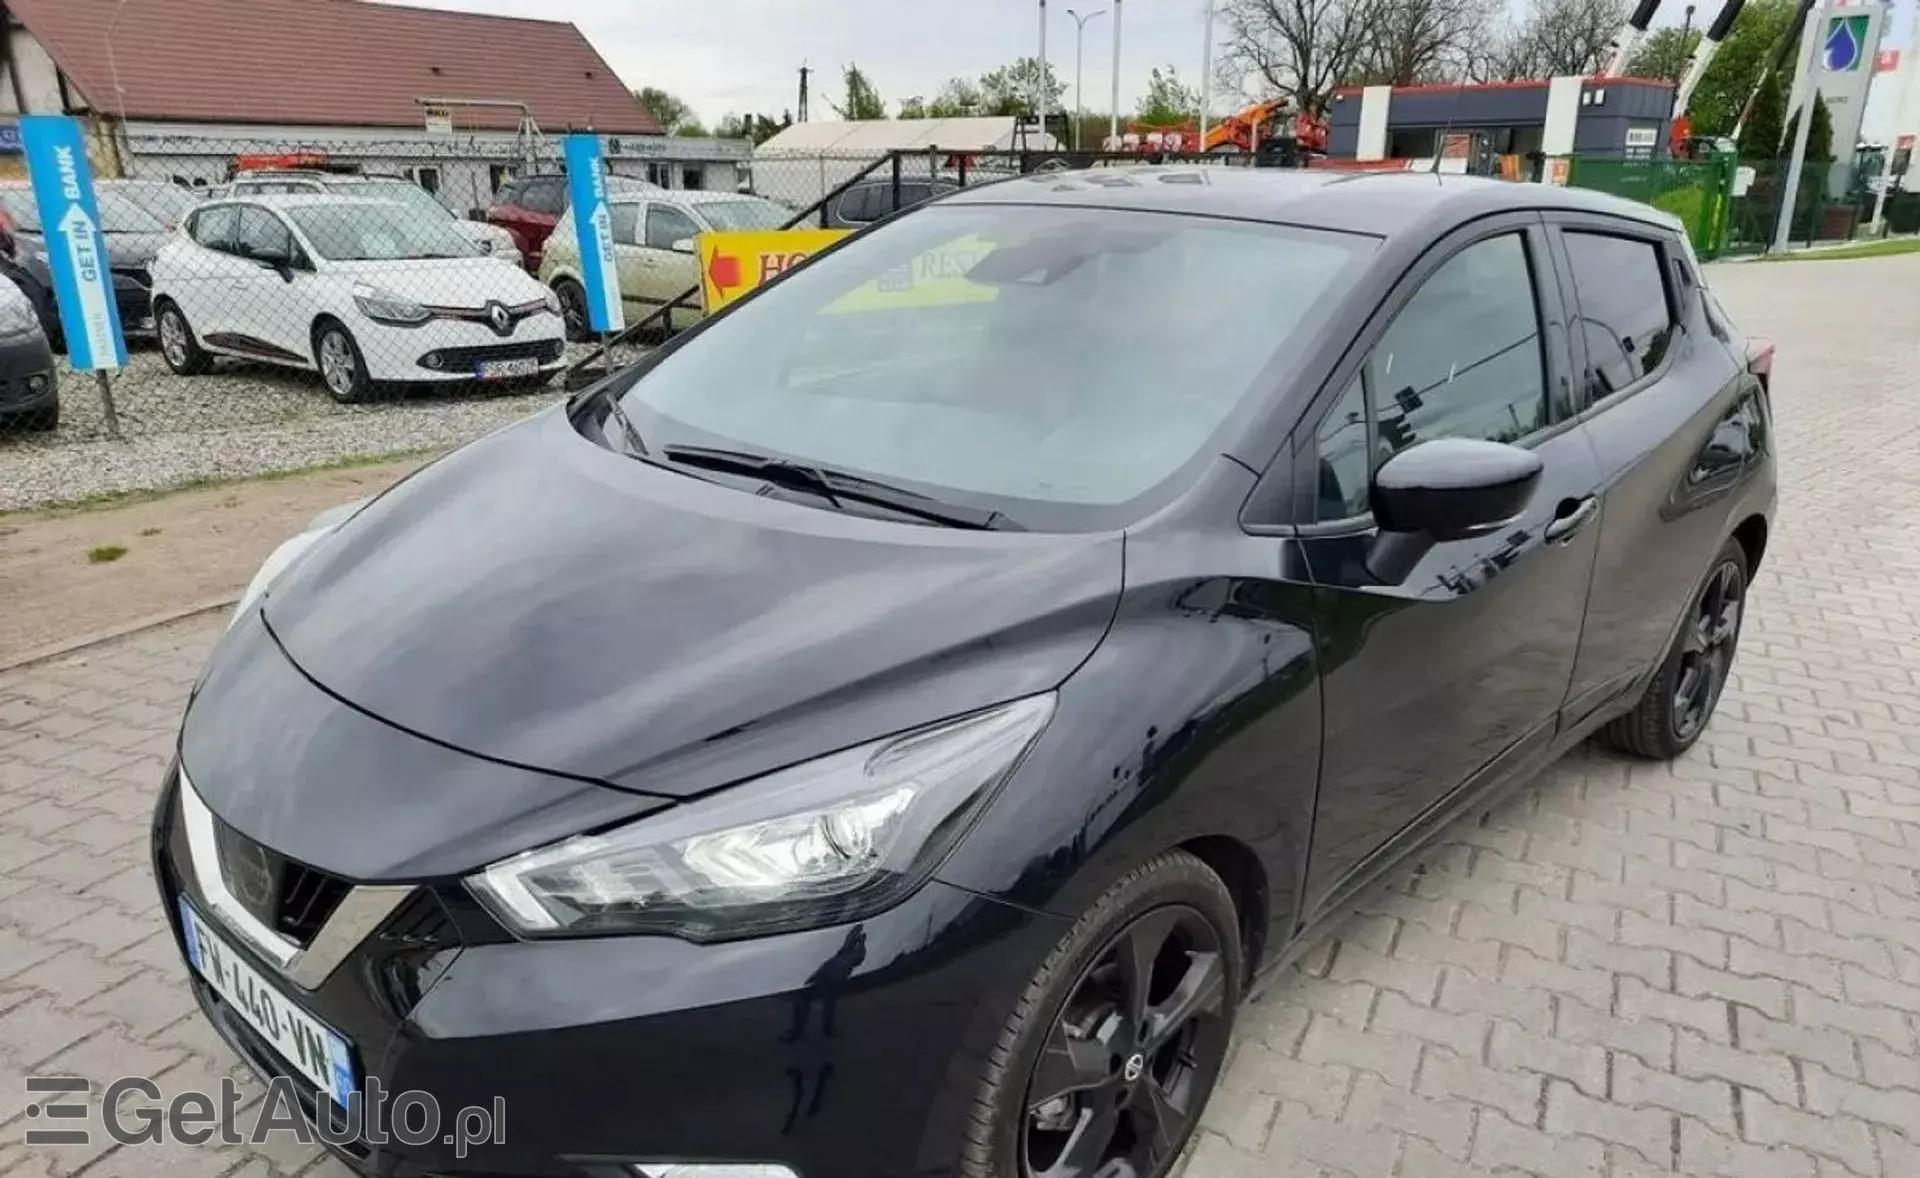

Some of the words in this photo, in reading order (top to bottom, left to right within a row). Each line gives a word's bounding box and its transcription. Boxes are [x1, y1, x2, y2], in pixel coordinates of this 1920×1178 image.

[52, 144, 82, 200] BANK
[590, 156, 603, 198] BANK
[71, 220, 92, 241] IN
[77, 244, 97, 281] GET
